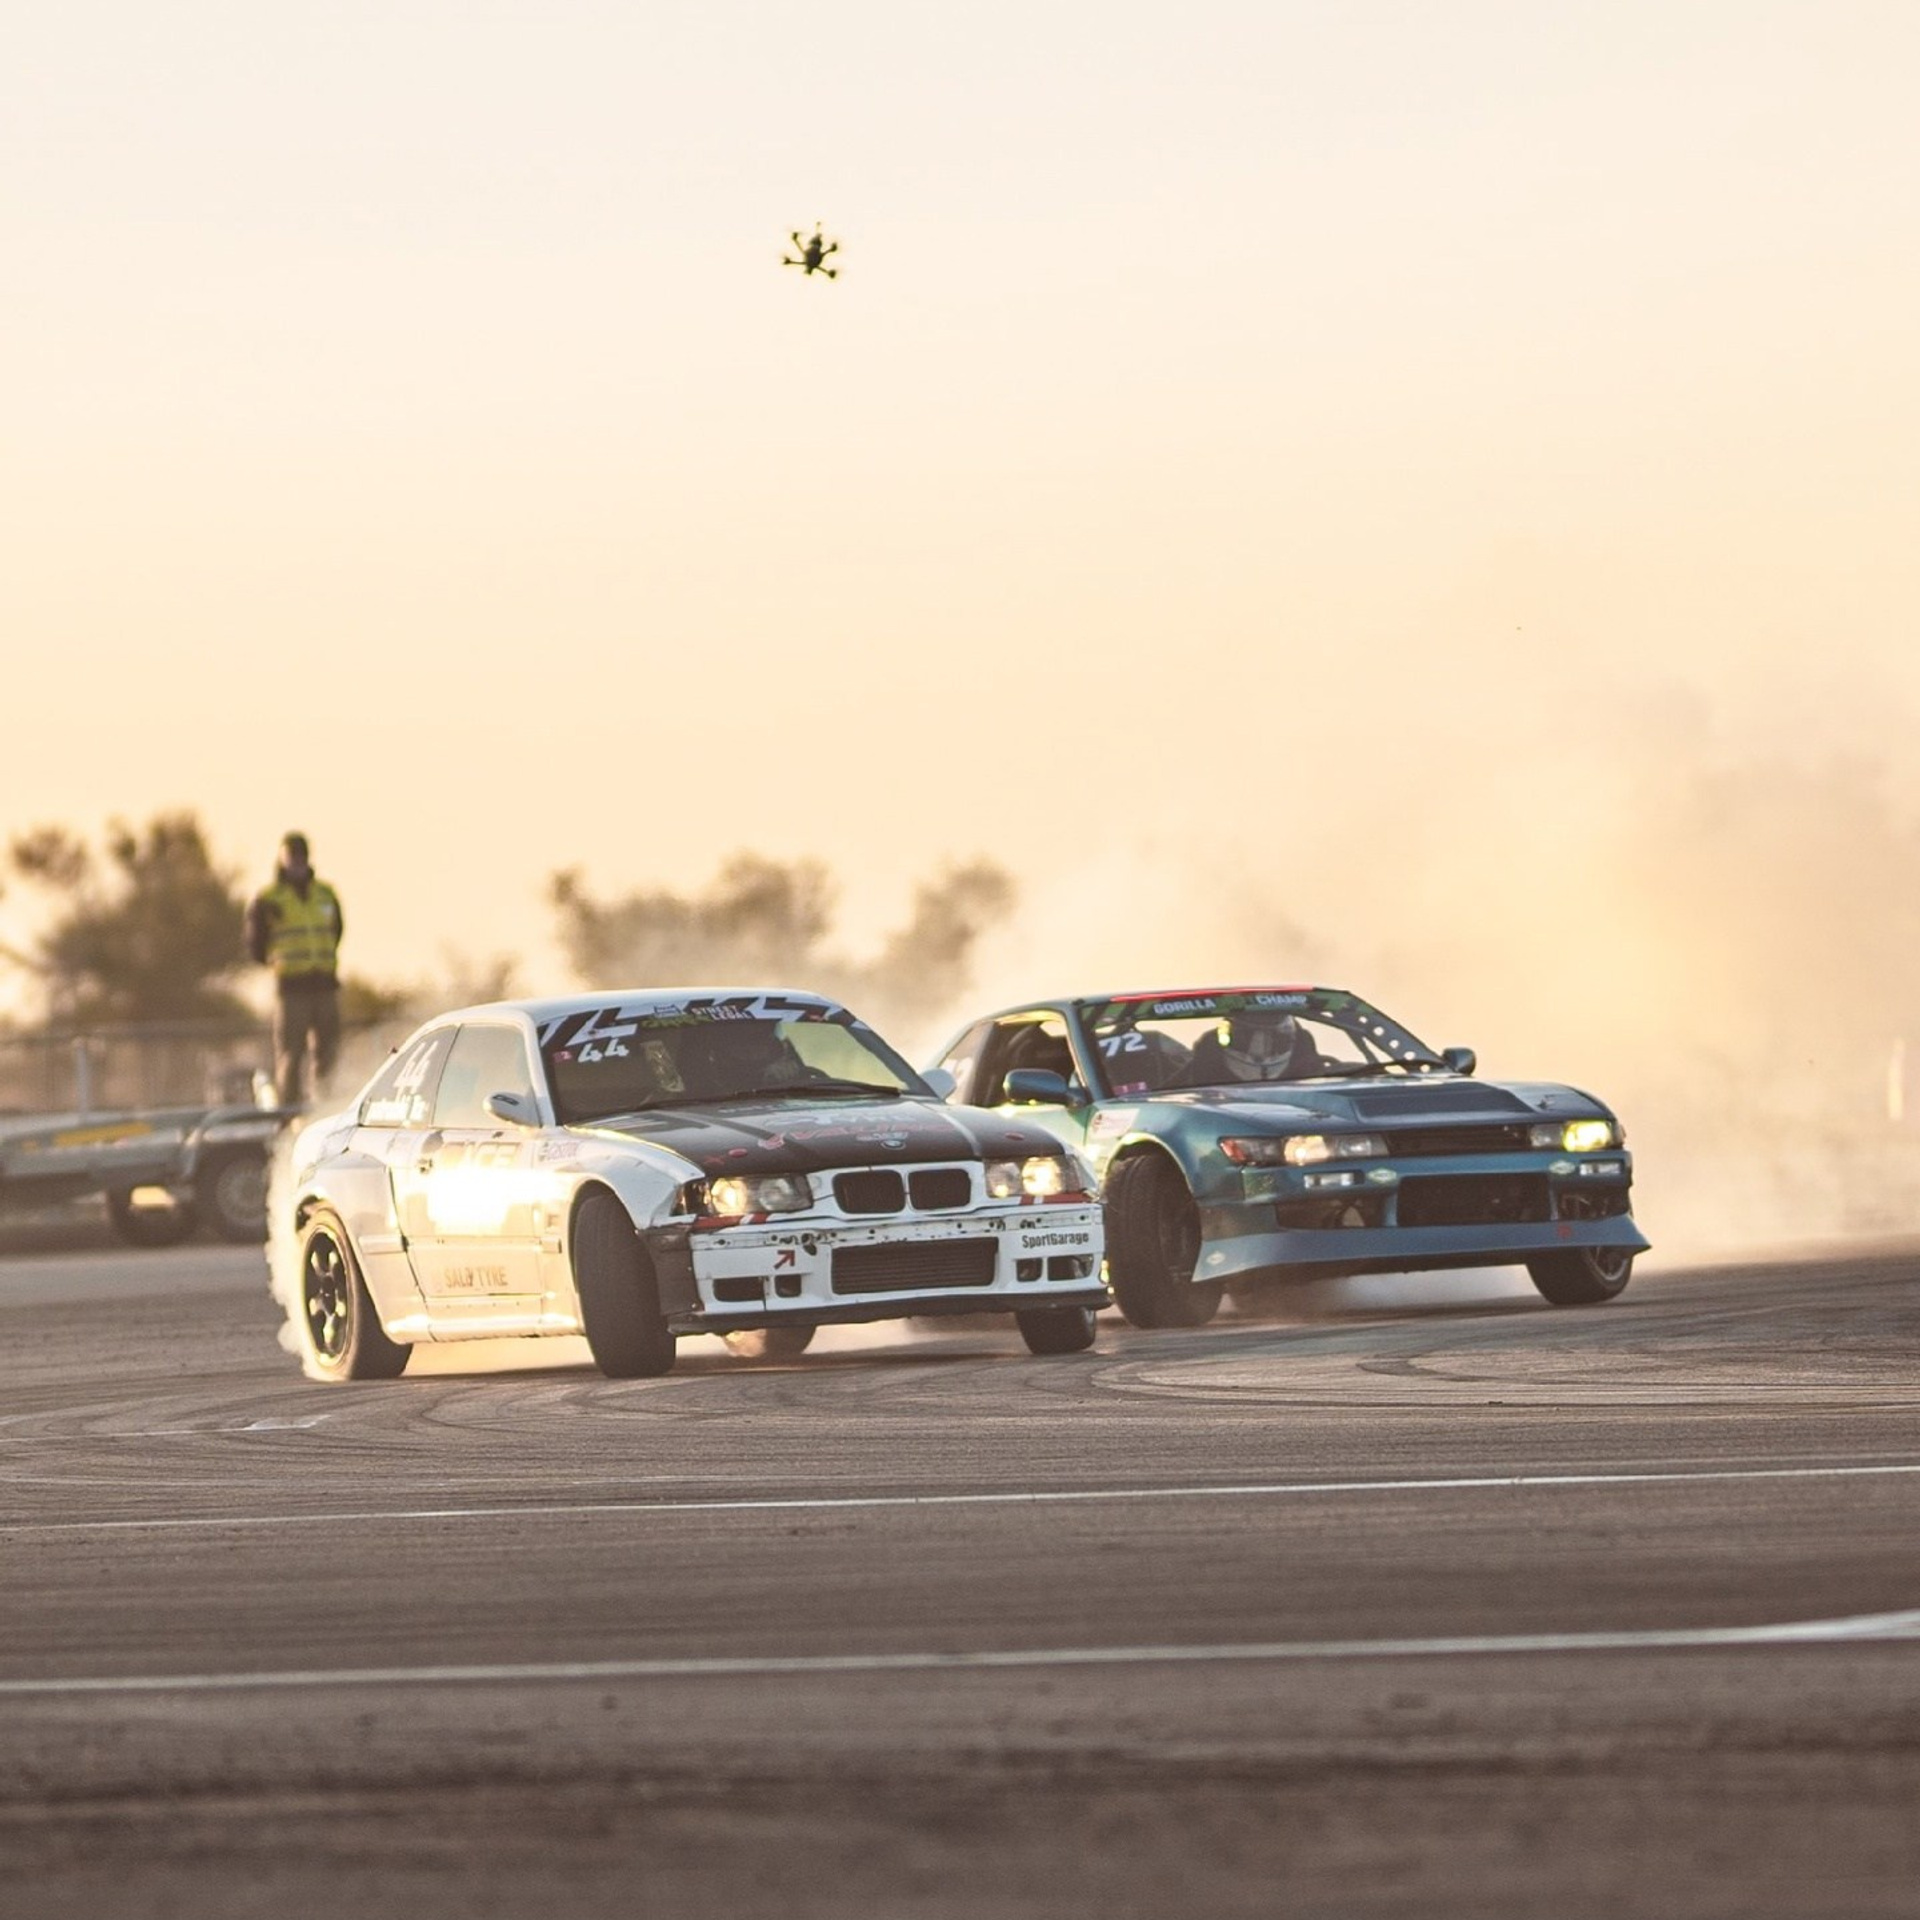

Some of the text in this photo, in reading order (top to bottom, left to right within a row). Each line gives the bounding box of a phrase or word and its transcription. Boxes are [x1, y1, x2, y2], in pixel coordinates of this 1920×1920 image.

[1153, 998, 1216, 1015] GORILLA
[577, 1037, 630, 1063] 44
[1098, 1032, 1147, 1057] 72
[393, 1040, 439, 1101] 44
[1021, 1232, 1090, 1249] SportGarage
